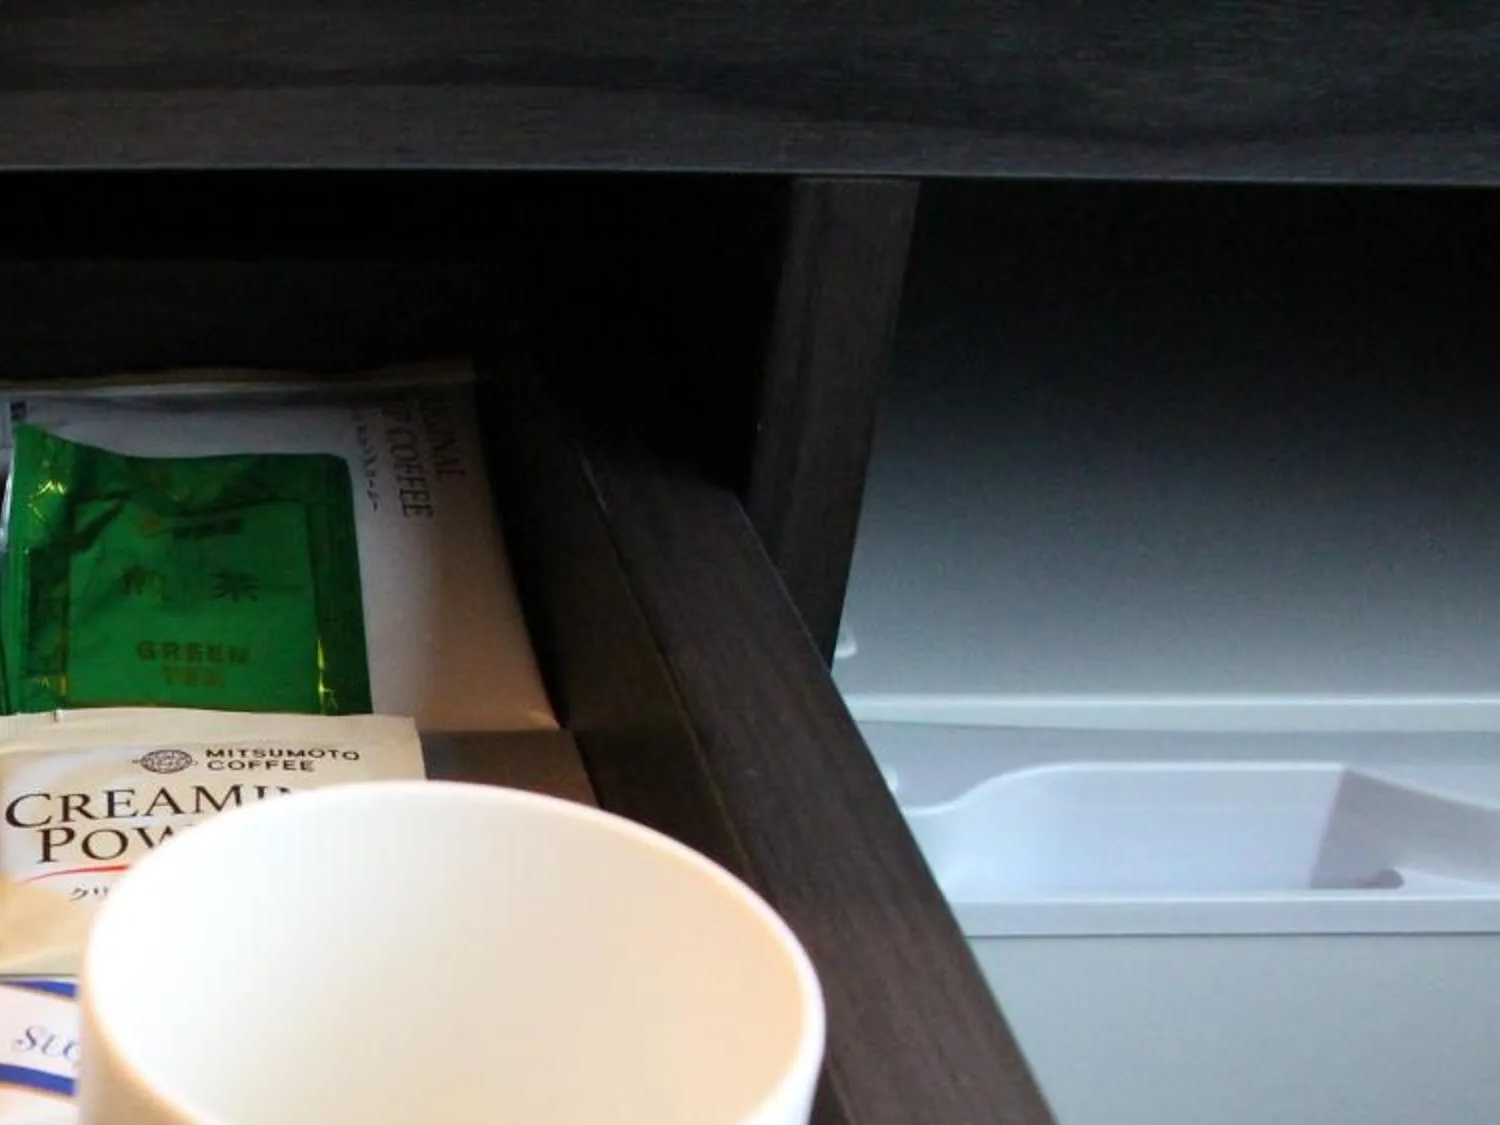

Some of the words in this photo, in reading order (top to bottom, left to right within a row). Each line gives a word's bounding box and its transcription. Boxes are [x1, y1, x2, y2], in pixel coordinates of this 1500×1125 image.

[386, 426, 434, 518] COFFEE
[137, 640, 248, 664] GREEN
[205, 748, 360, 761] MITSUMOTO
[206, 760, 315, 772] COFFEE
[5, 784, 291, 829] CREAM
